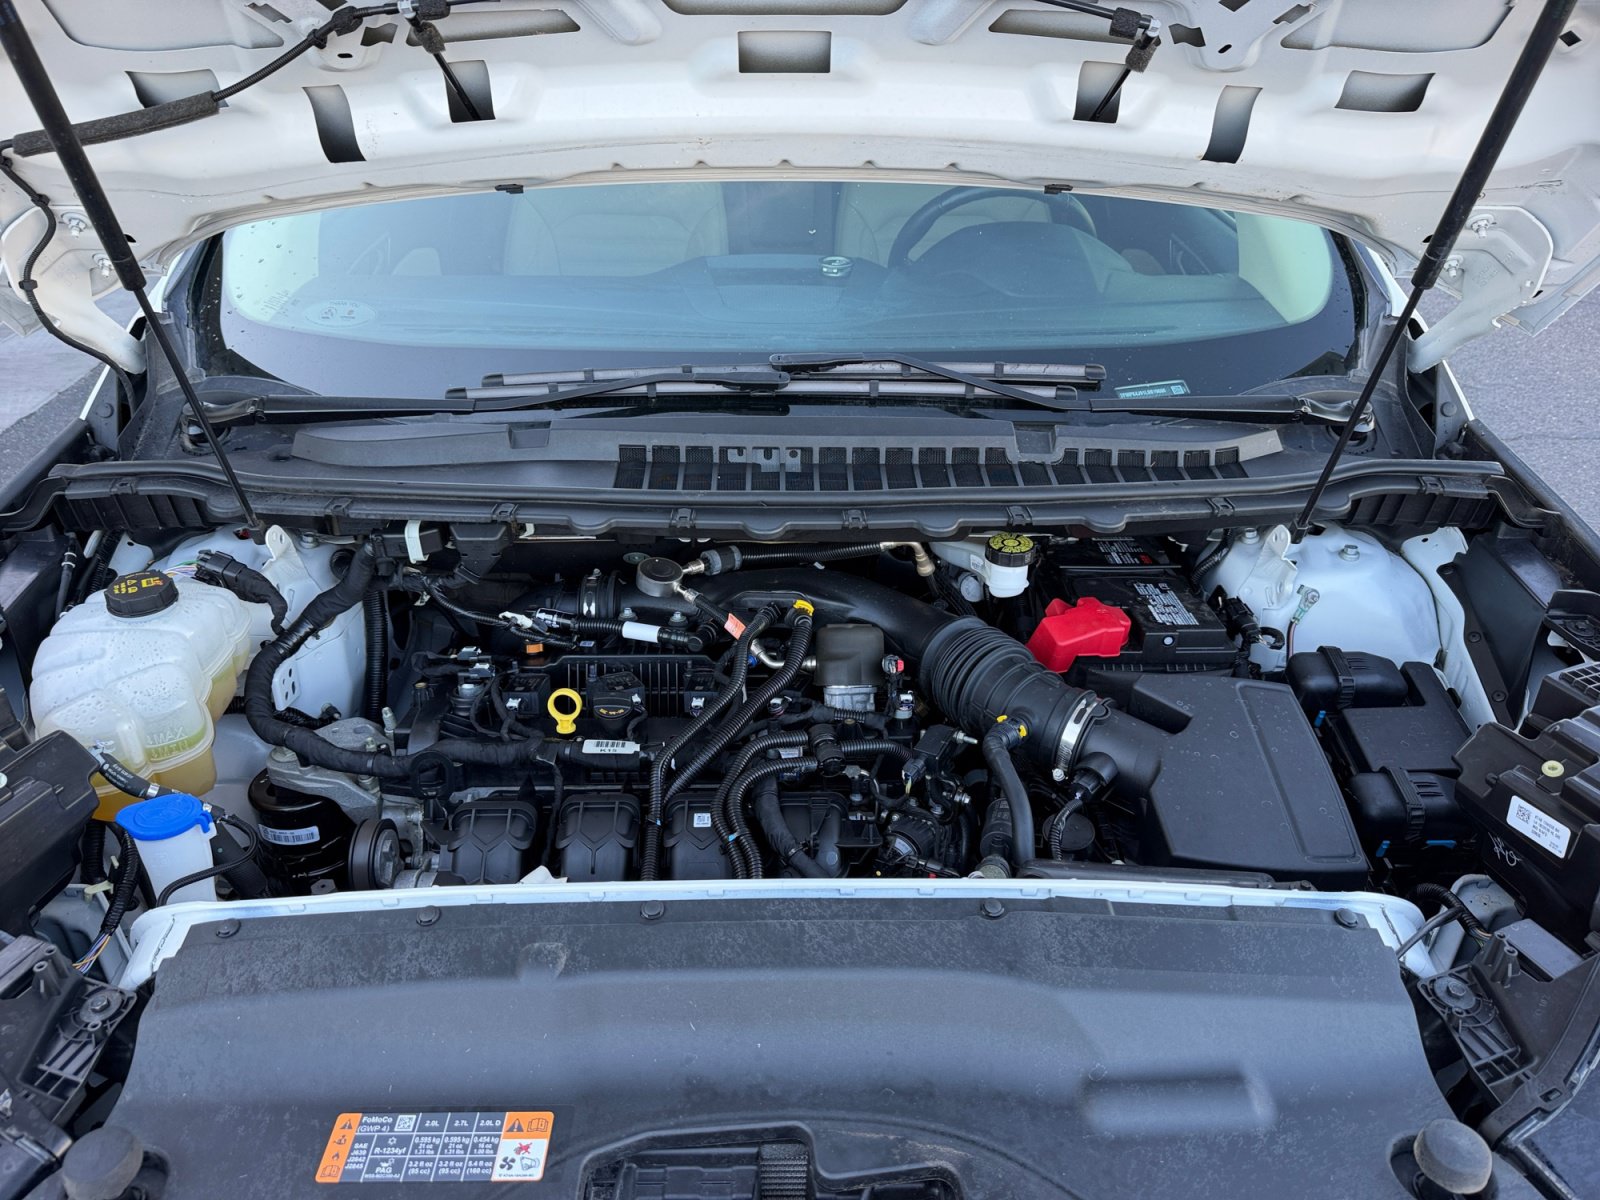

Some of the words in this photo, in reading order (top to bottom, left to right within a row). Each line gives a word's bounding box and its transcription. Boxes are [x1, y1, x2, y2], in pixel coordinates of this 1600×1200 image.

[154, 727, 186, 745] MAX
[159, 740, 188, 757] MIN
[357, 1125, 380, 1133] (GWP
[381, 1125, 390, 1133] 4)
[374, 1147, 406, 1155] R-1234yf
